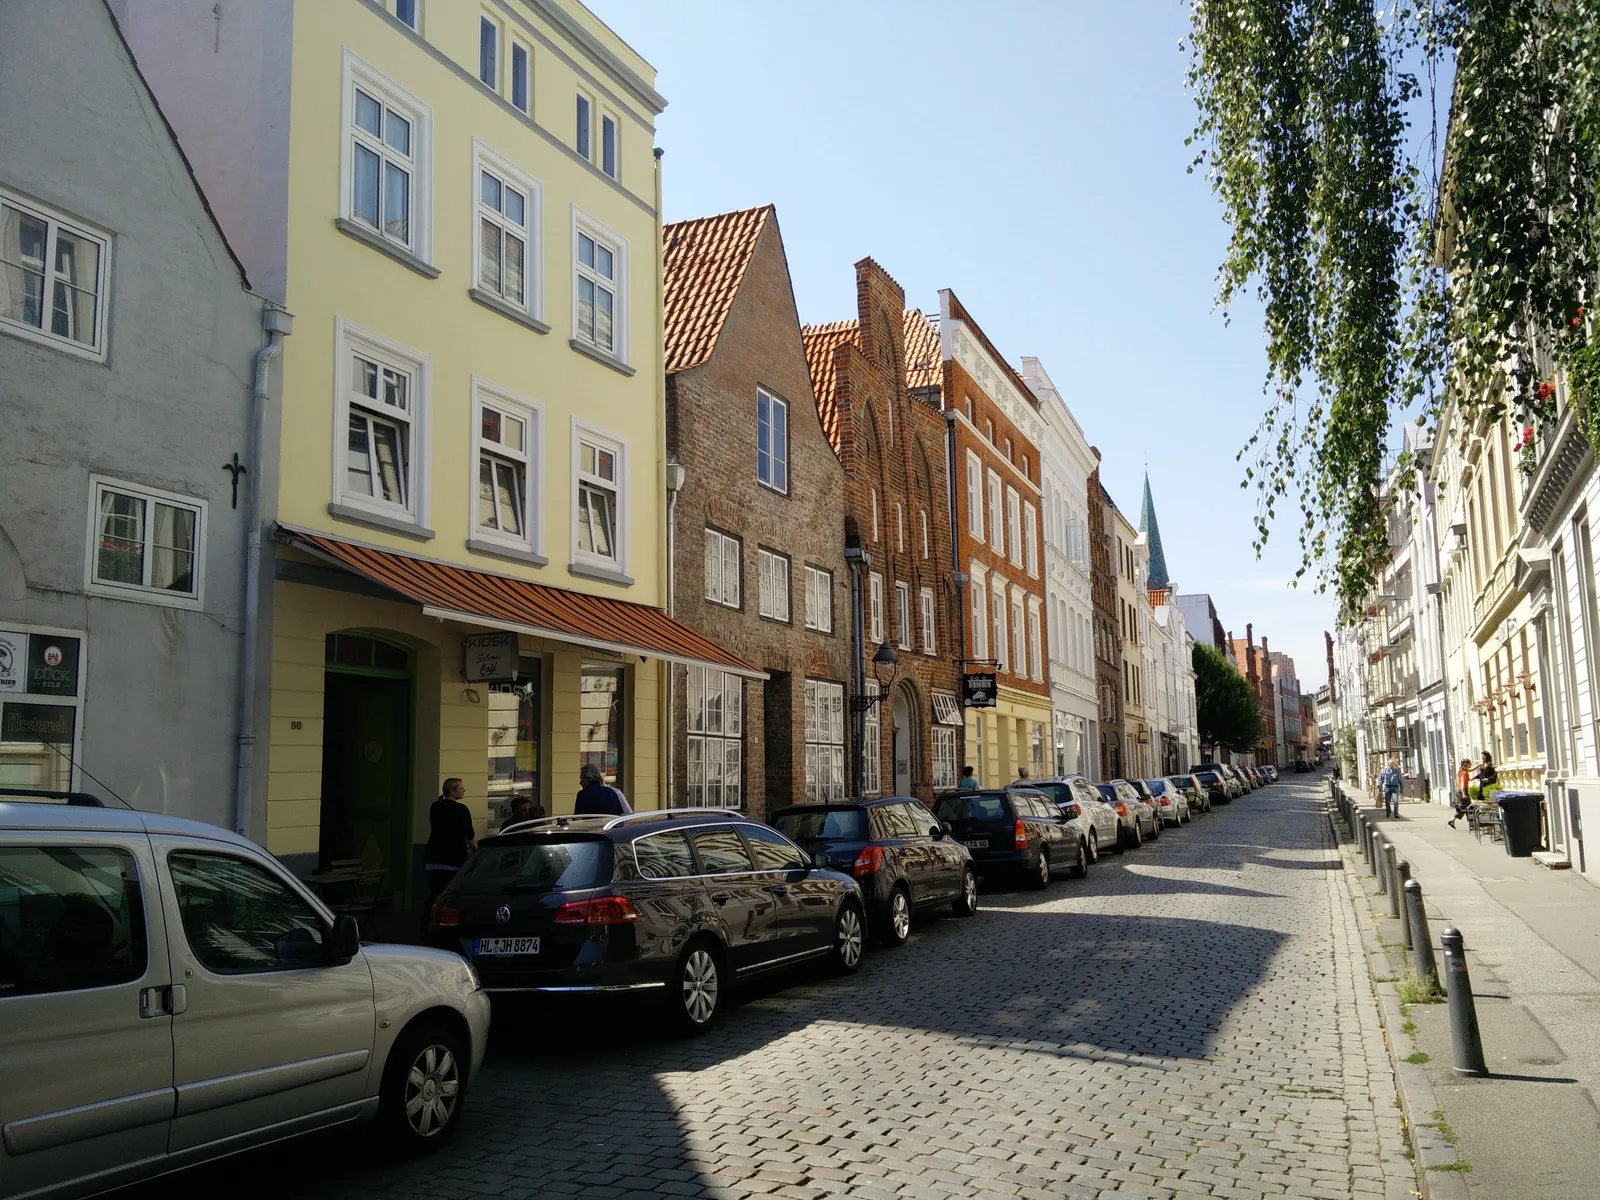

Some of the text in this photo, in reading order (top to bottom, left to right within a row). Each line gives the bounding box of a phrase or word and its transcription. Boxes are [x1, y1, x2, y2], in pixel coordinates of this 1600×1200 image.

[468, 635, 510, 648] KIOSK
[479, 662, 498, 676] Café
[7, 712, 68, 734] Klostereck
[480, 938, 538, 953] HL JH 8874
